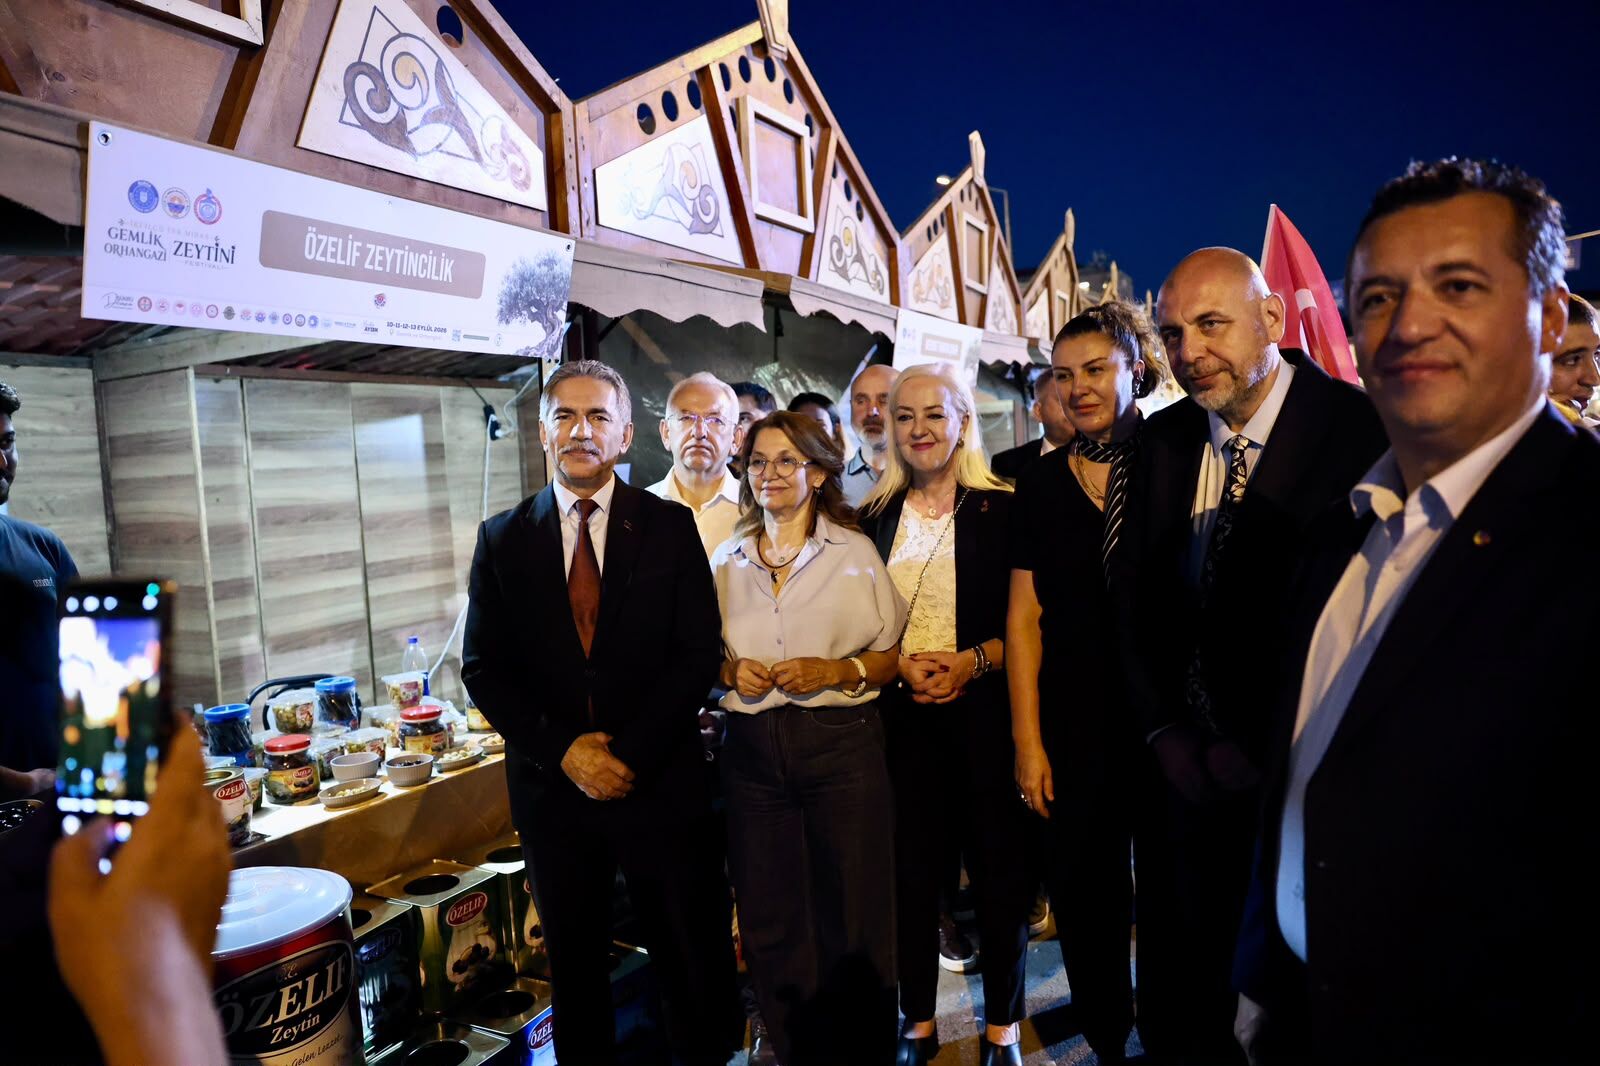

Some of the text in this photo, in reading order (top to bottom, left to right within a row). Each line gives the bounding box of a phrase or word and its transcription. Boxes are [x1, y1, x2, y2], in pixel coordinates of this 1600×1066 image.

[107, 226, 164, 247] GEMLİK
[173, 239, 236, 264] ZEYTİNİ
[304, 226, 454, 283] ÖZELİF ZEYTİNCİLİK
[270, 1012, 320, 1045] Zeytin
[530, 1021, 553, 1046] ÖZEL
